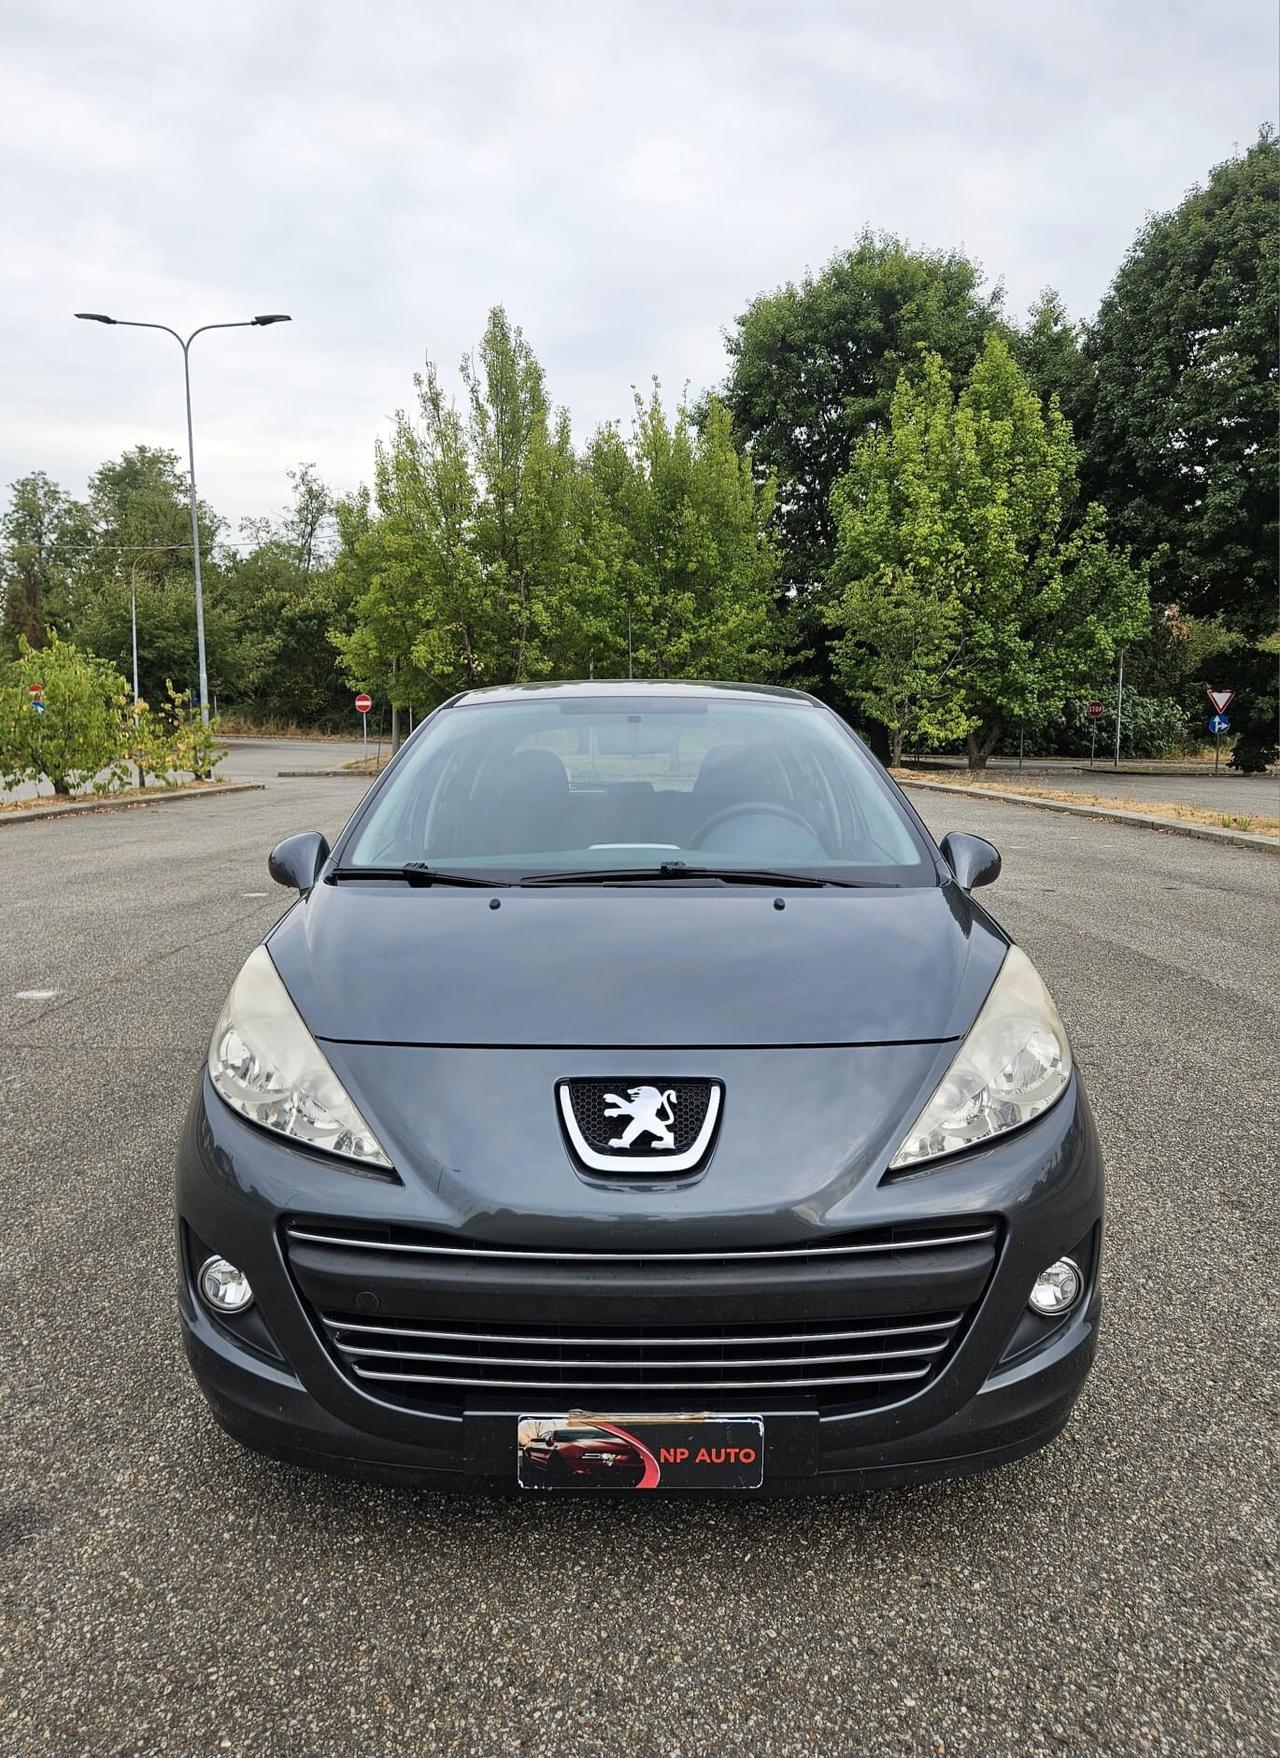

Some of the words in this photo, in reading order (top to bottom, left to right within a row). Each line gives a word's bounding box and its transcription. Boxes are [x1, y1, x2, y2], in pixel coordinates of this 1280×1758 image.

[1089, 705, 1102, 713] STOP
[660, 1448, 689, 1463] NP
[695, 1448, 756, 1463] AUTO
